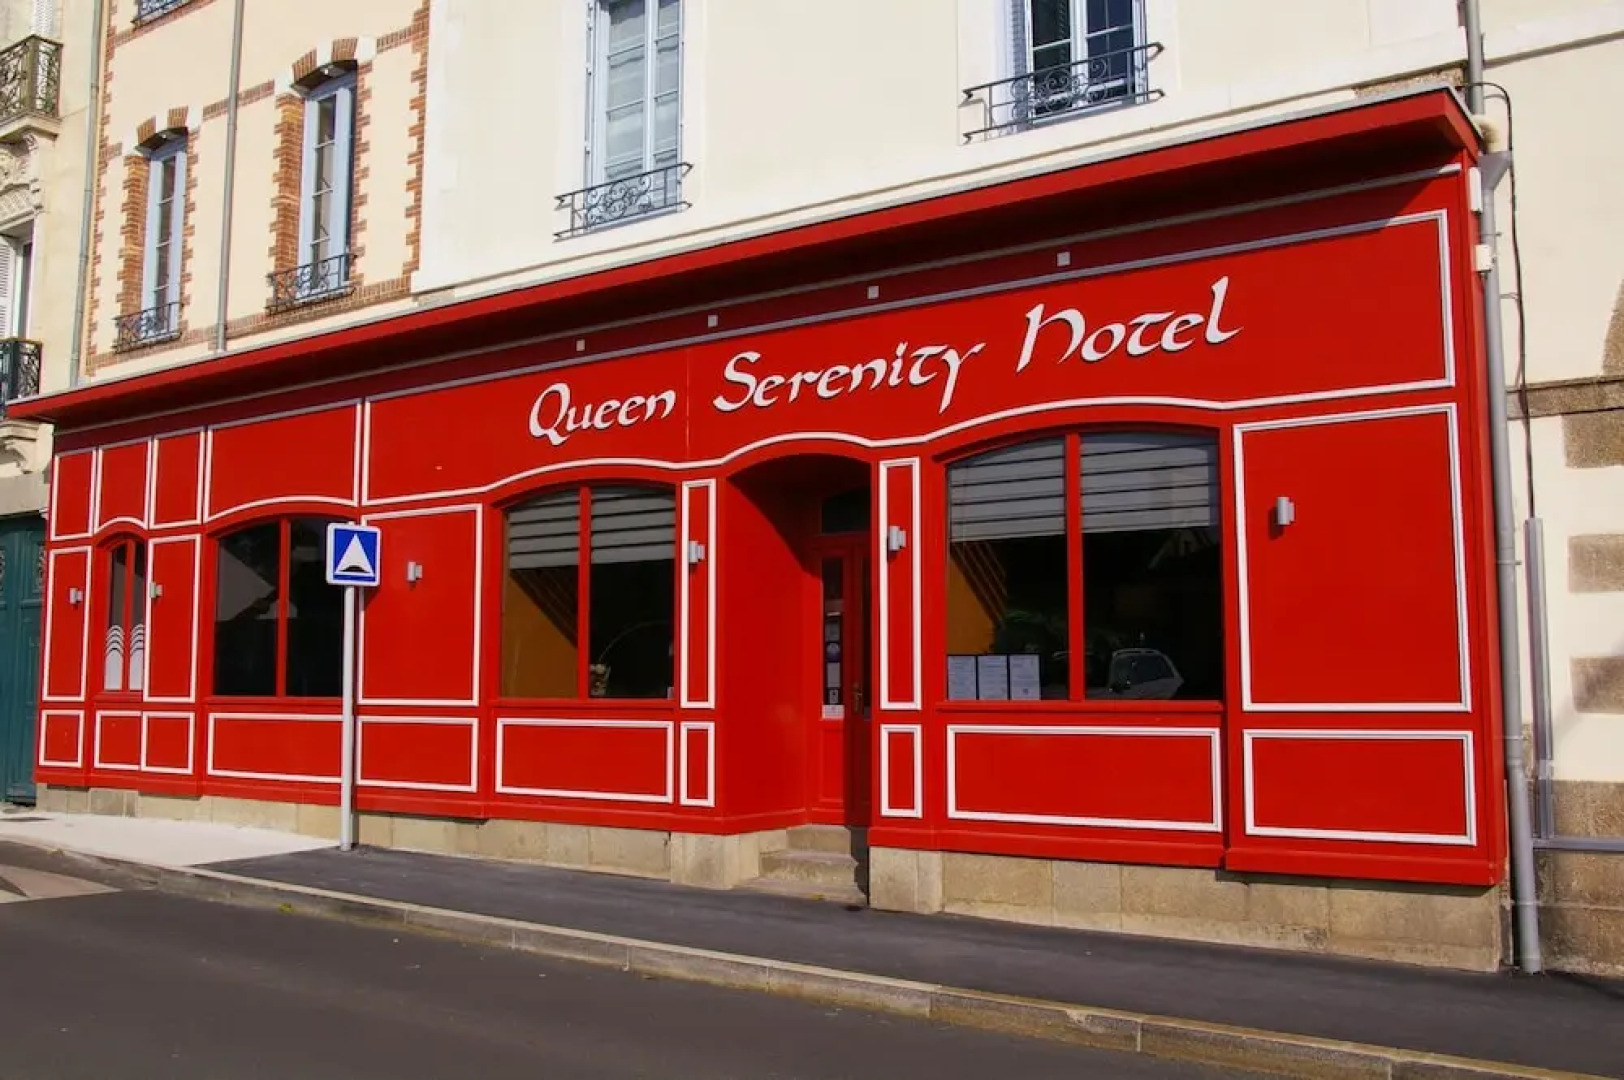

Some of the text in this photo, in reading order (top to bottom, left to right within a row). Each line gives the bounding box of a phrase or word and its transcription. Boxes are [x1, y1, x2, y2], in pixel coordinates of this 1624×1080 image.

[528, 275, 1242, 447] Queen Serenity Hotel
